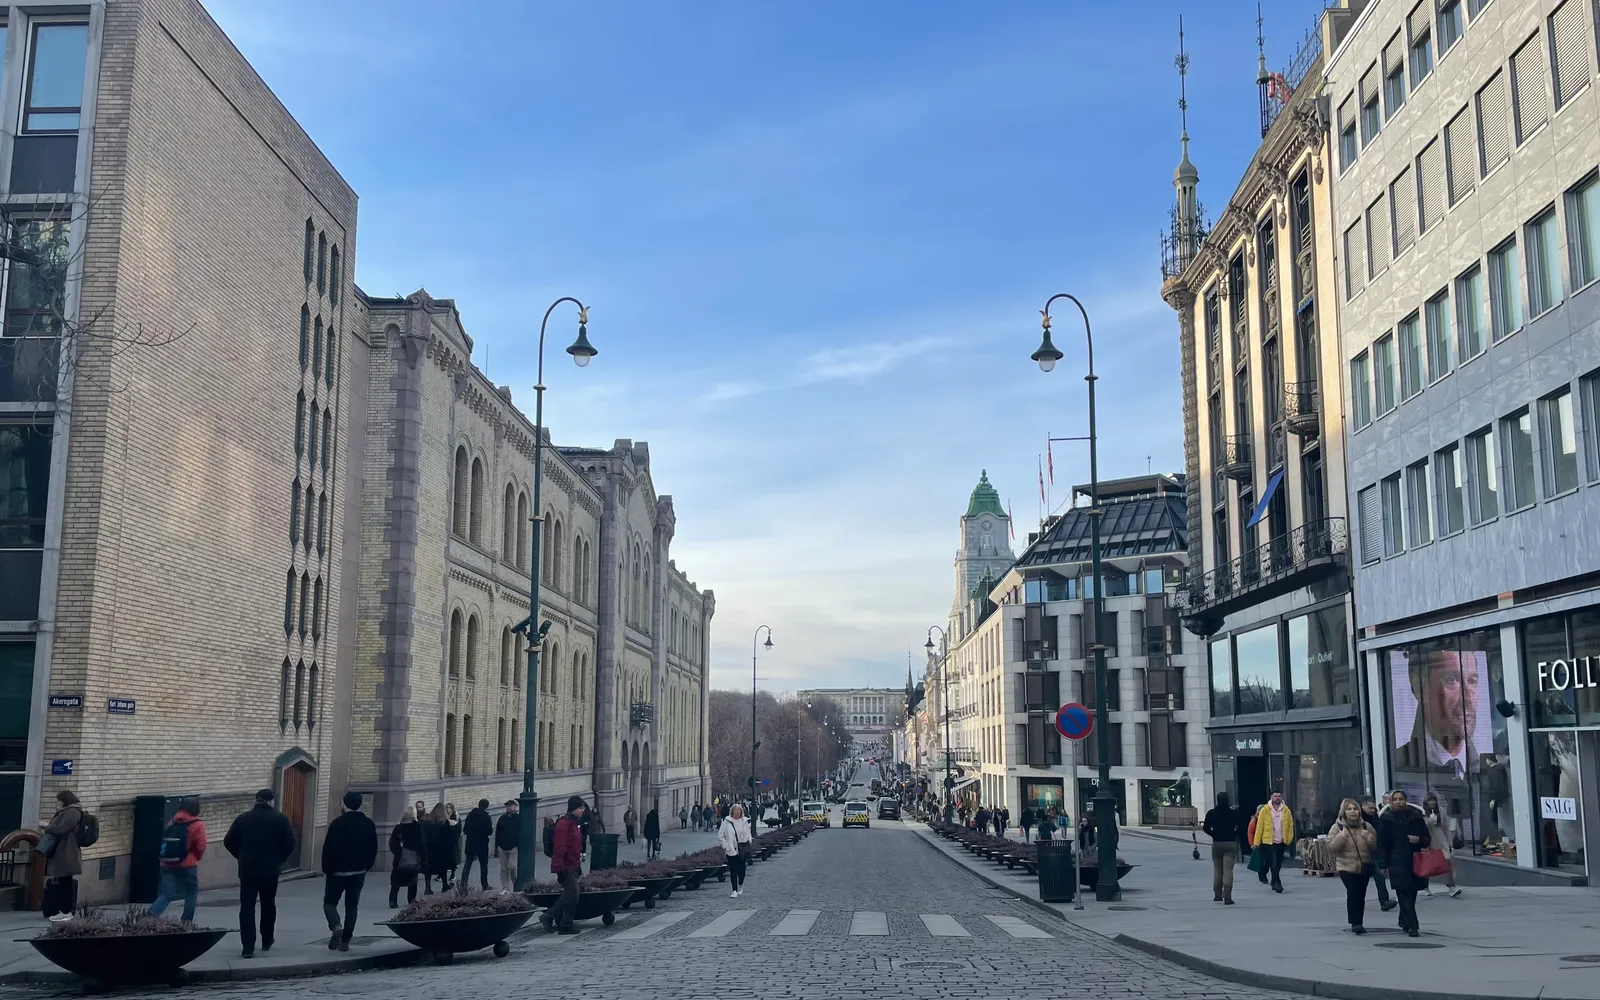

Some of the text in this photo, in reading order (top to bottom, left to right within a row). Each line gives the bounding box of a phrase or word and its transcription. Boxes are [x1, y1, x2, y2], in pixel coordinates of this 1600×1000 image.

[1538, 655, 1600, 692] FOLL
[52, 698, 79, 706] Akersgata
[1236, 739, 1261, 751] Sport Outlet
[1545, 799, 1571, 814] SALG
